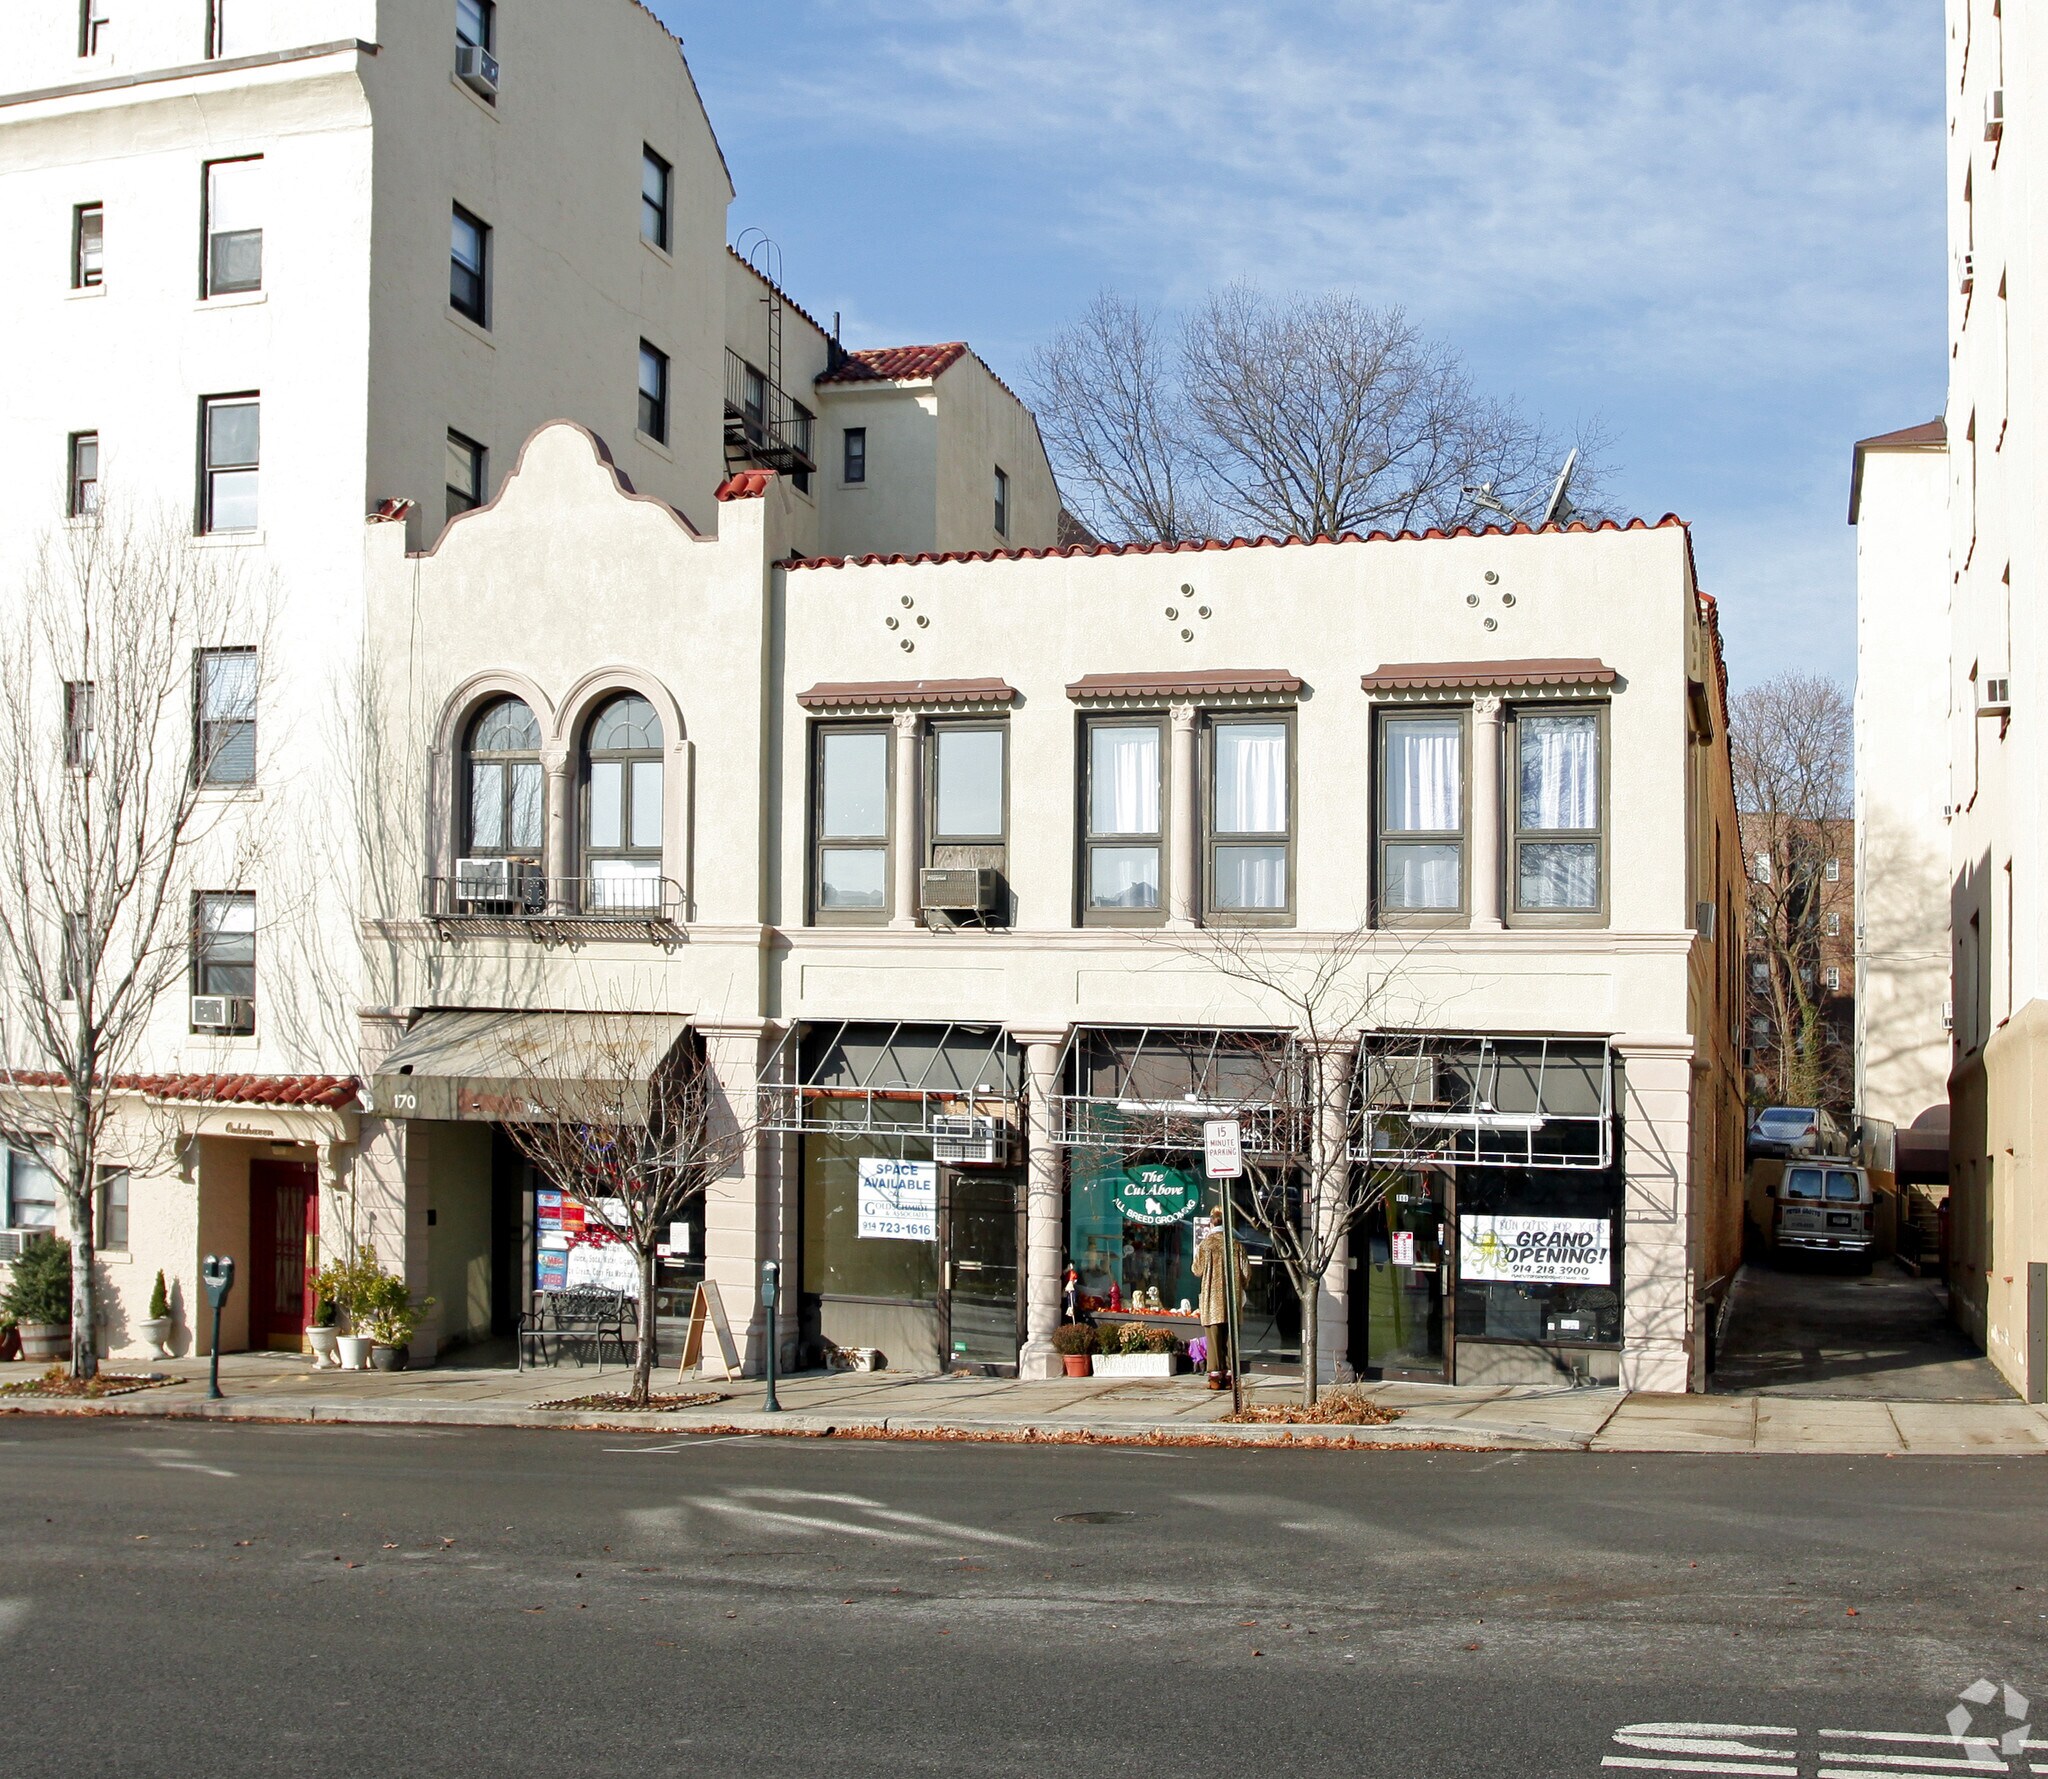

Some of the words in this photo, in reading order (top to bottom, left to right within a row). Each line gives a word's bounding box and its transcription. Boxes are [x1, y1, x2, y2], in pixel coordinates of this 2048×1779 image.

[394, 1094, 416, 1109] 170
[1217, 1126, 1227, 1138] 15
[1210, 1139, 1235, 1147] MINUTE
[1210, 1148, 1237, 1156] PARKING
[876, 1164, 918, 1176] SPACE
[1141, 1170, 1164, 1183] The
[863, 1178, 931, 1191] AVAILABLE
[1124, 1183, 1146, 1196] Cut
[1145, 1183, 1184, 1196] Above
[864, 1201, 928, 1216] GOLDSCHMIDT
[1112, 1198, 1126, 1213] ALL
[1126, 1208, 1154, 1224] BREED
[1154, 1199, 1196, 1225] GROOMING
[863, 1221, 877, 1230] 914
[879, 1222, 931, 1236] 723-1616
[1516, 1231, 1594, 1248] GRAND
[1506, 1248, 1607, 1264] OPENING!
[1512, 1264, 1589, 1276] 914.218.3900
